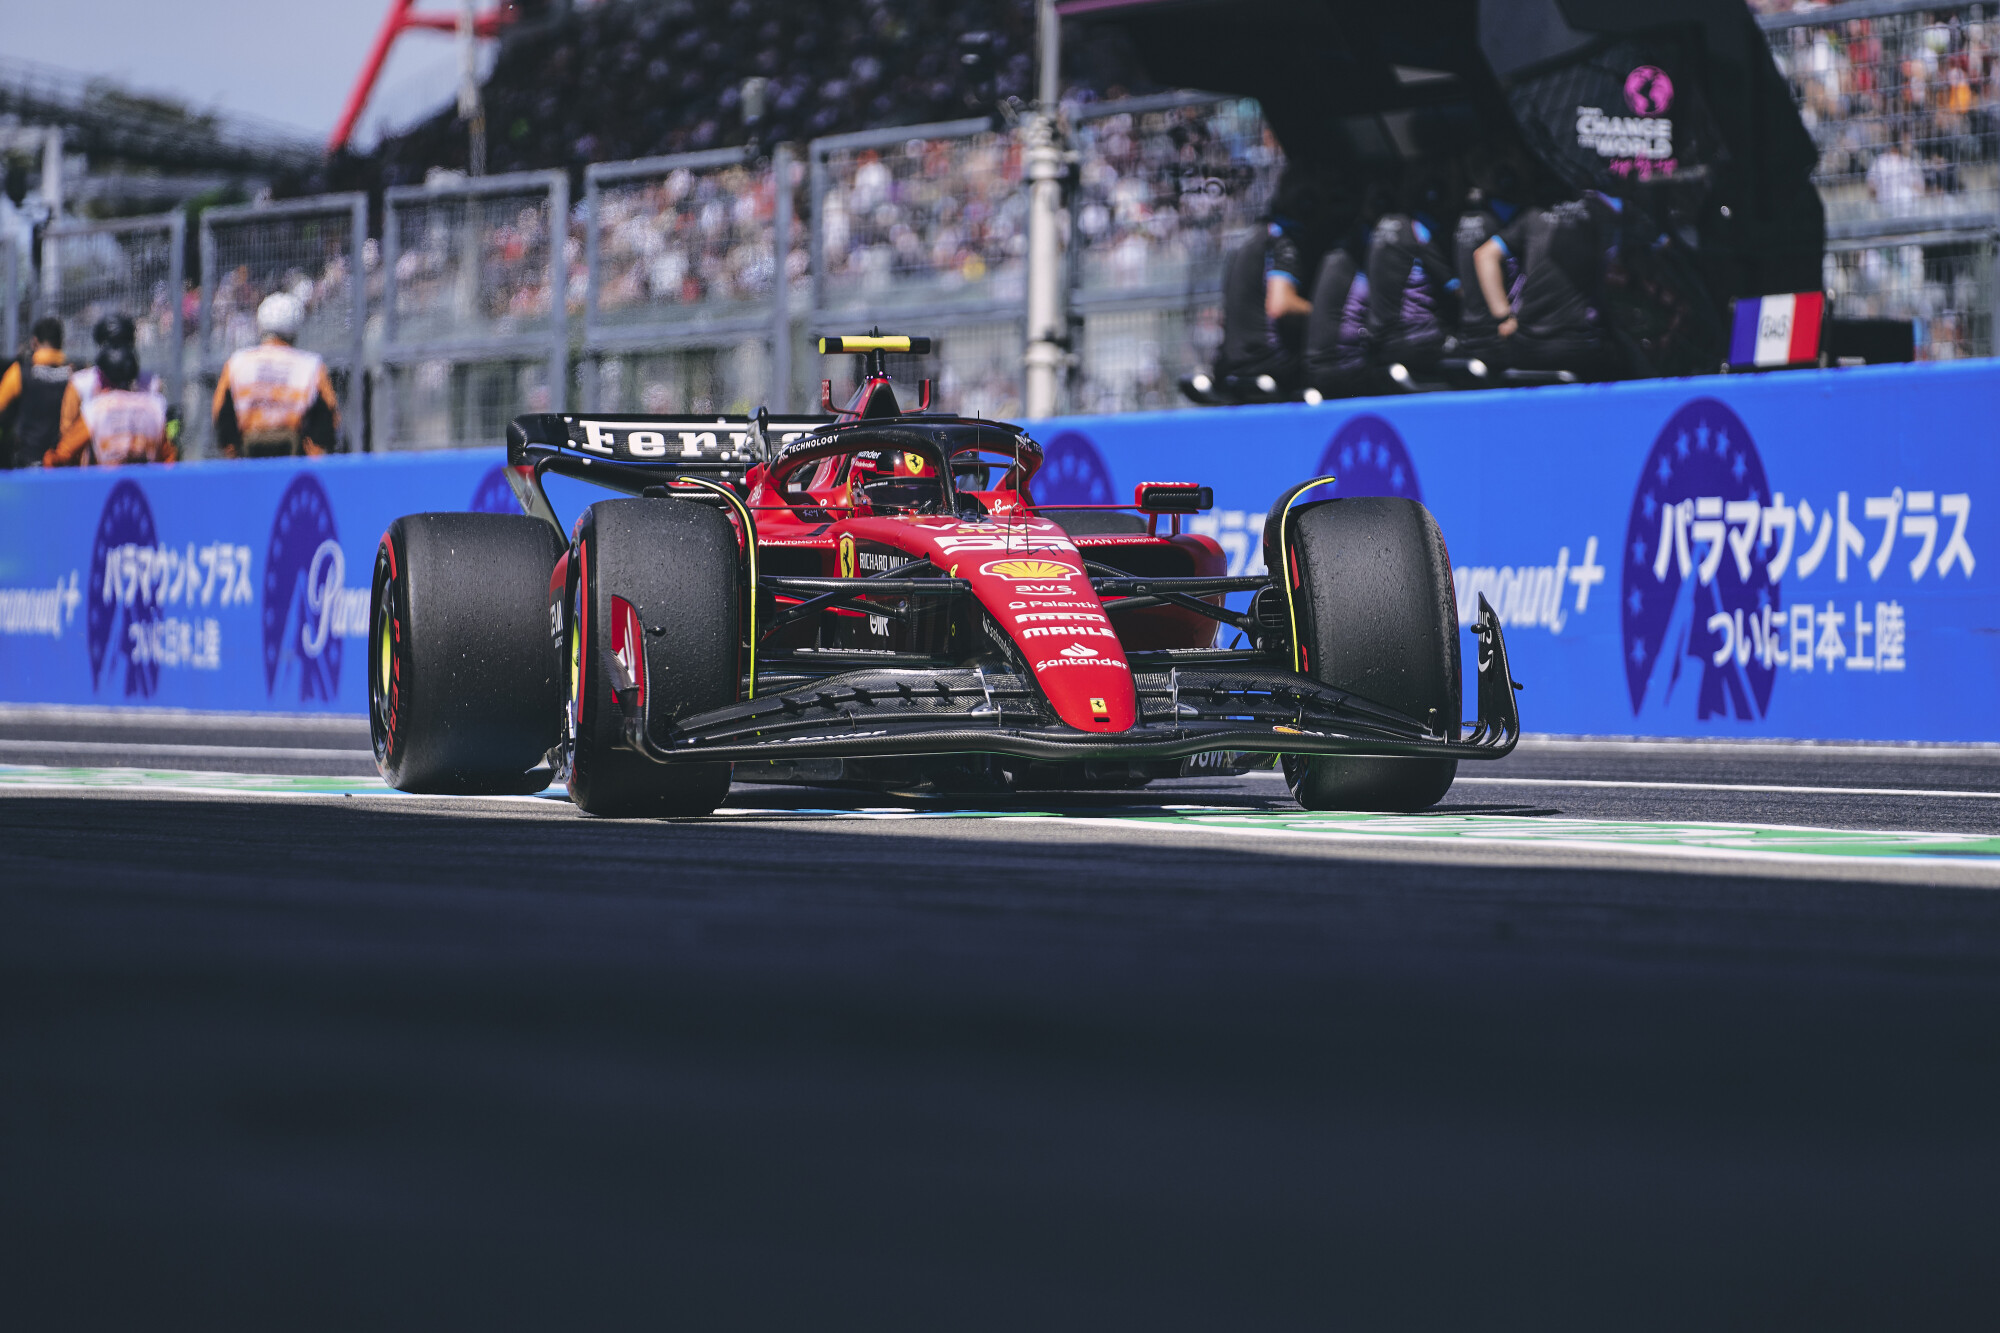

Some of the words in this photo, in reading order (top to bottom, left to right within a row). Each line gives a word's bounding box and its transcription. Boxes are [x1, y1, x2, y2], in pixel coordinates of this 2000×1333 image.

[789, 434, 839, 454] TECHNOLOGY
[915, 523, 1055, 531] VGW
[1652, 486, 1977, 586] パラマウントプラス
[933, 535, 1079, 556] 55
[860, 552, 888, 571] RICHARD
[102, 541, 254, 609] パラマウントプラス
[1015, 584, 1073, 592] aws
[1029, 600, 1099, 609] Palantir
[1014, 612, 1107, 624] PIRELLI
[1022, 625, 1117, 639] MAHLE
[1706, 599, 1907, 674] ついに日本上陸
[1036, 656, 1129, 673] Santander
